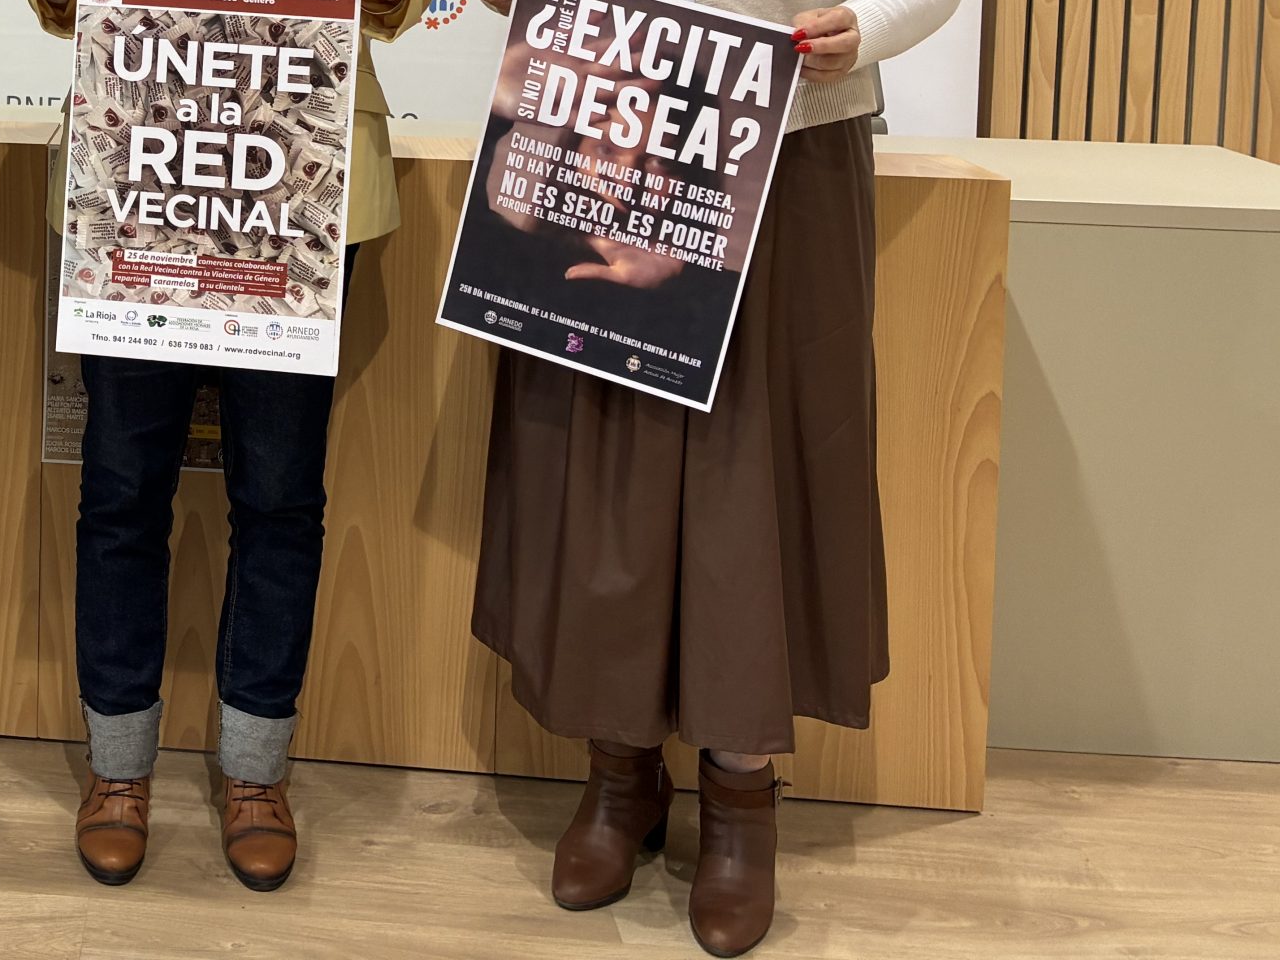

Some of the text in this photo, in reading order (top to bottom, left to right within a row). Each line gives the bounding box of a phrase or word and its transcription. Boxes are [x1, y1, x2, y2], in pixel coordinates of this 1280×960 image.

[558, 8, 573, 29] QUÉ
[113, 24, 314, 94] ÚNETE
[552, 31, 567, 52] POR
[517, 58, 546, 118] SI NO TE
[176, 92, 242, 125] a la
[536, 63, 761, 177] DESEA?
[129, 125, 287, 191] RED
[511, 132, 734, 212] CUANDO UNA MUJER NO TE DESEA,
[506, 152, 732, 228] NO HAY ENCUENTRO, HAY DOMINIO
[107, 189, 305, 237] VECINAL
[497, 195, 723, 270] PORQUE EL DESEO NO SE COMPRA, SE COMPARTE
[500, 170, 727, 257] NO ES SEXO, ES PODER
[127, 251, 137, 259] 25
[139, 252, 148, 260] de
[150, 253, 193, 264] noviembre
[198, 258, 232, 267] comercios
[233, 261, 283, 271] colaboradores
[153, 265, 178, 273] Vecinal
[211, 270, 243, 279] Violencia
[254, 274, 279, 282] Género
[114, 274, 149, 285] repartirán
[153, 277, 195, 287] caramelos
[214, 282, 244, 291] clientela
[86, 310, 116, 321] La Rioja
[287, 326, 320, 336] ARNEDO
[459, 283, 700, 367] 25N DÍA INTERNACIONAL DE LA ELIMINACIÓN DE LA VIOLENCIA CONTRA LA MUJER
[499, 316, 522, 328] ARNEDO
[91, 334, 110, 342] Tfno.
[224, 346, 301, 360] www.redvecinal.org
